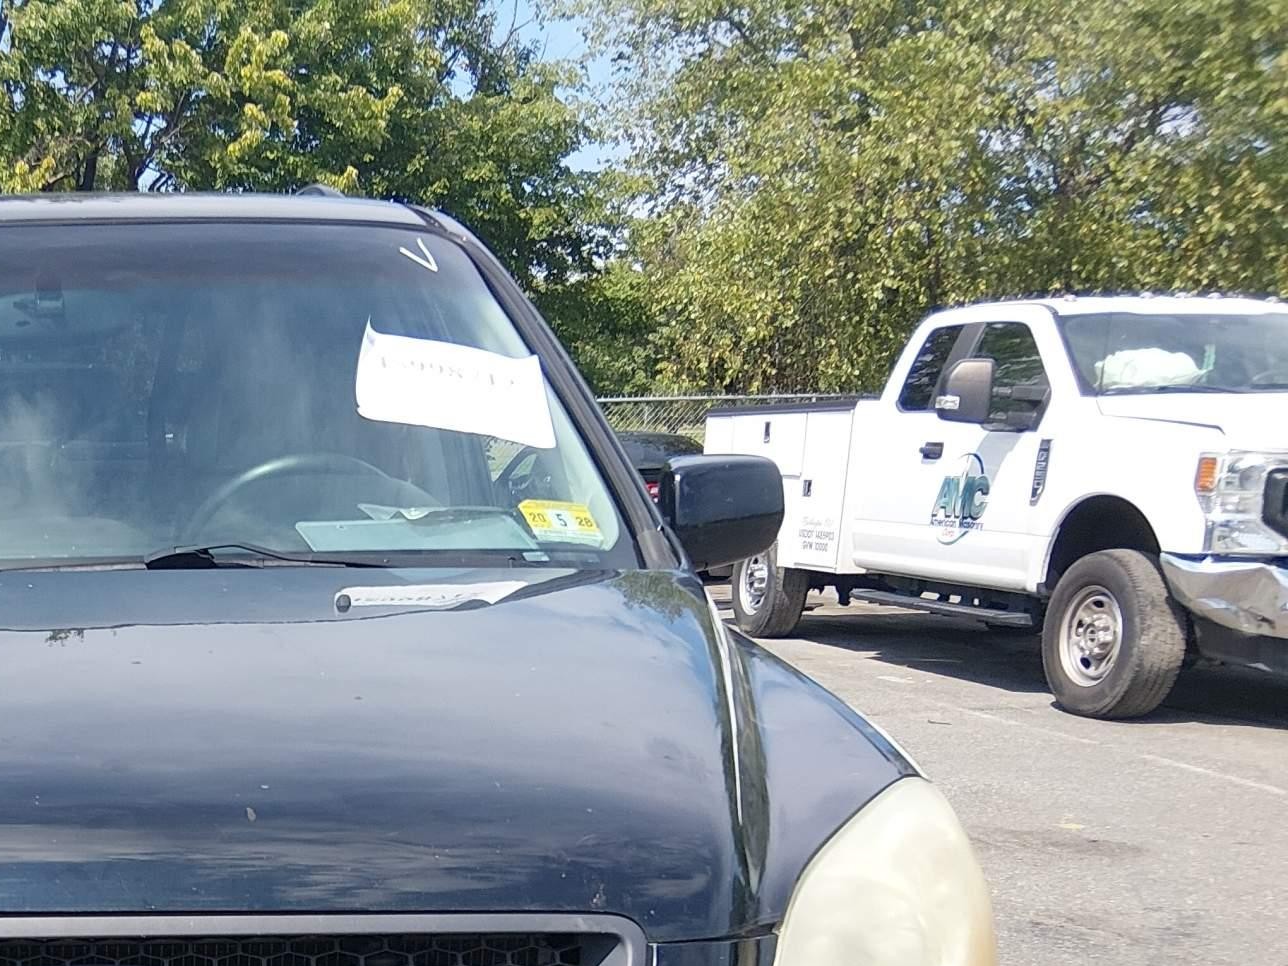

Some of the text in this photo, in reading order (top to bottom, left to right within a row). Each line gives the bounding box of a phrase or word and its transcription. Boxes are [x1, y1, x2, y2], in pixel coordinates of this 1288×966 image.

[931, 475, 990, 521] AMC
[529, 512, 547, 523] 20
[555, 513, 568, 527] 5
